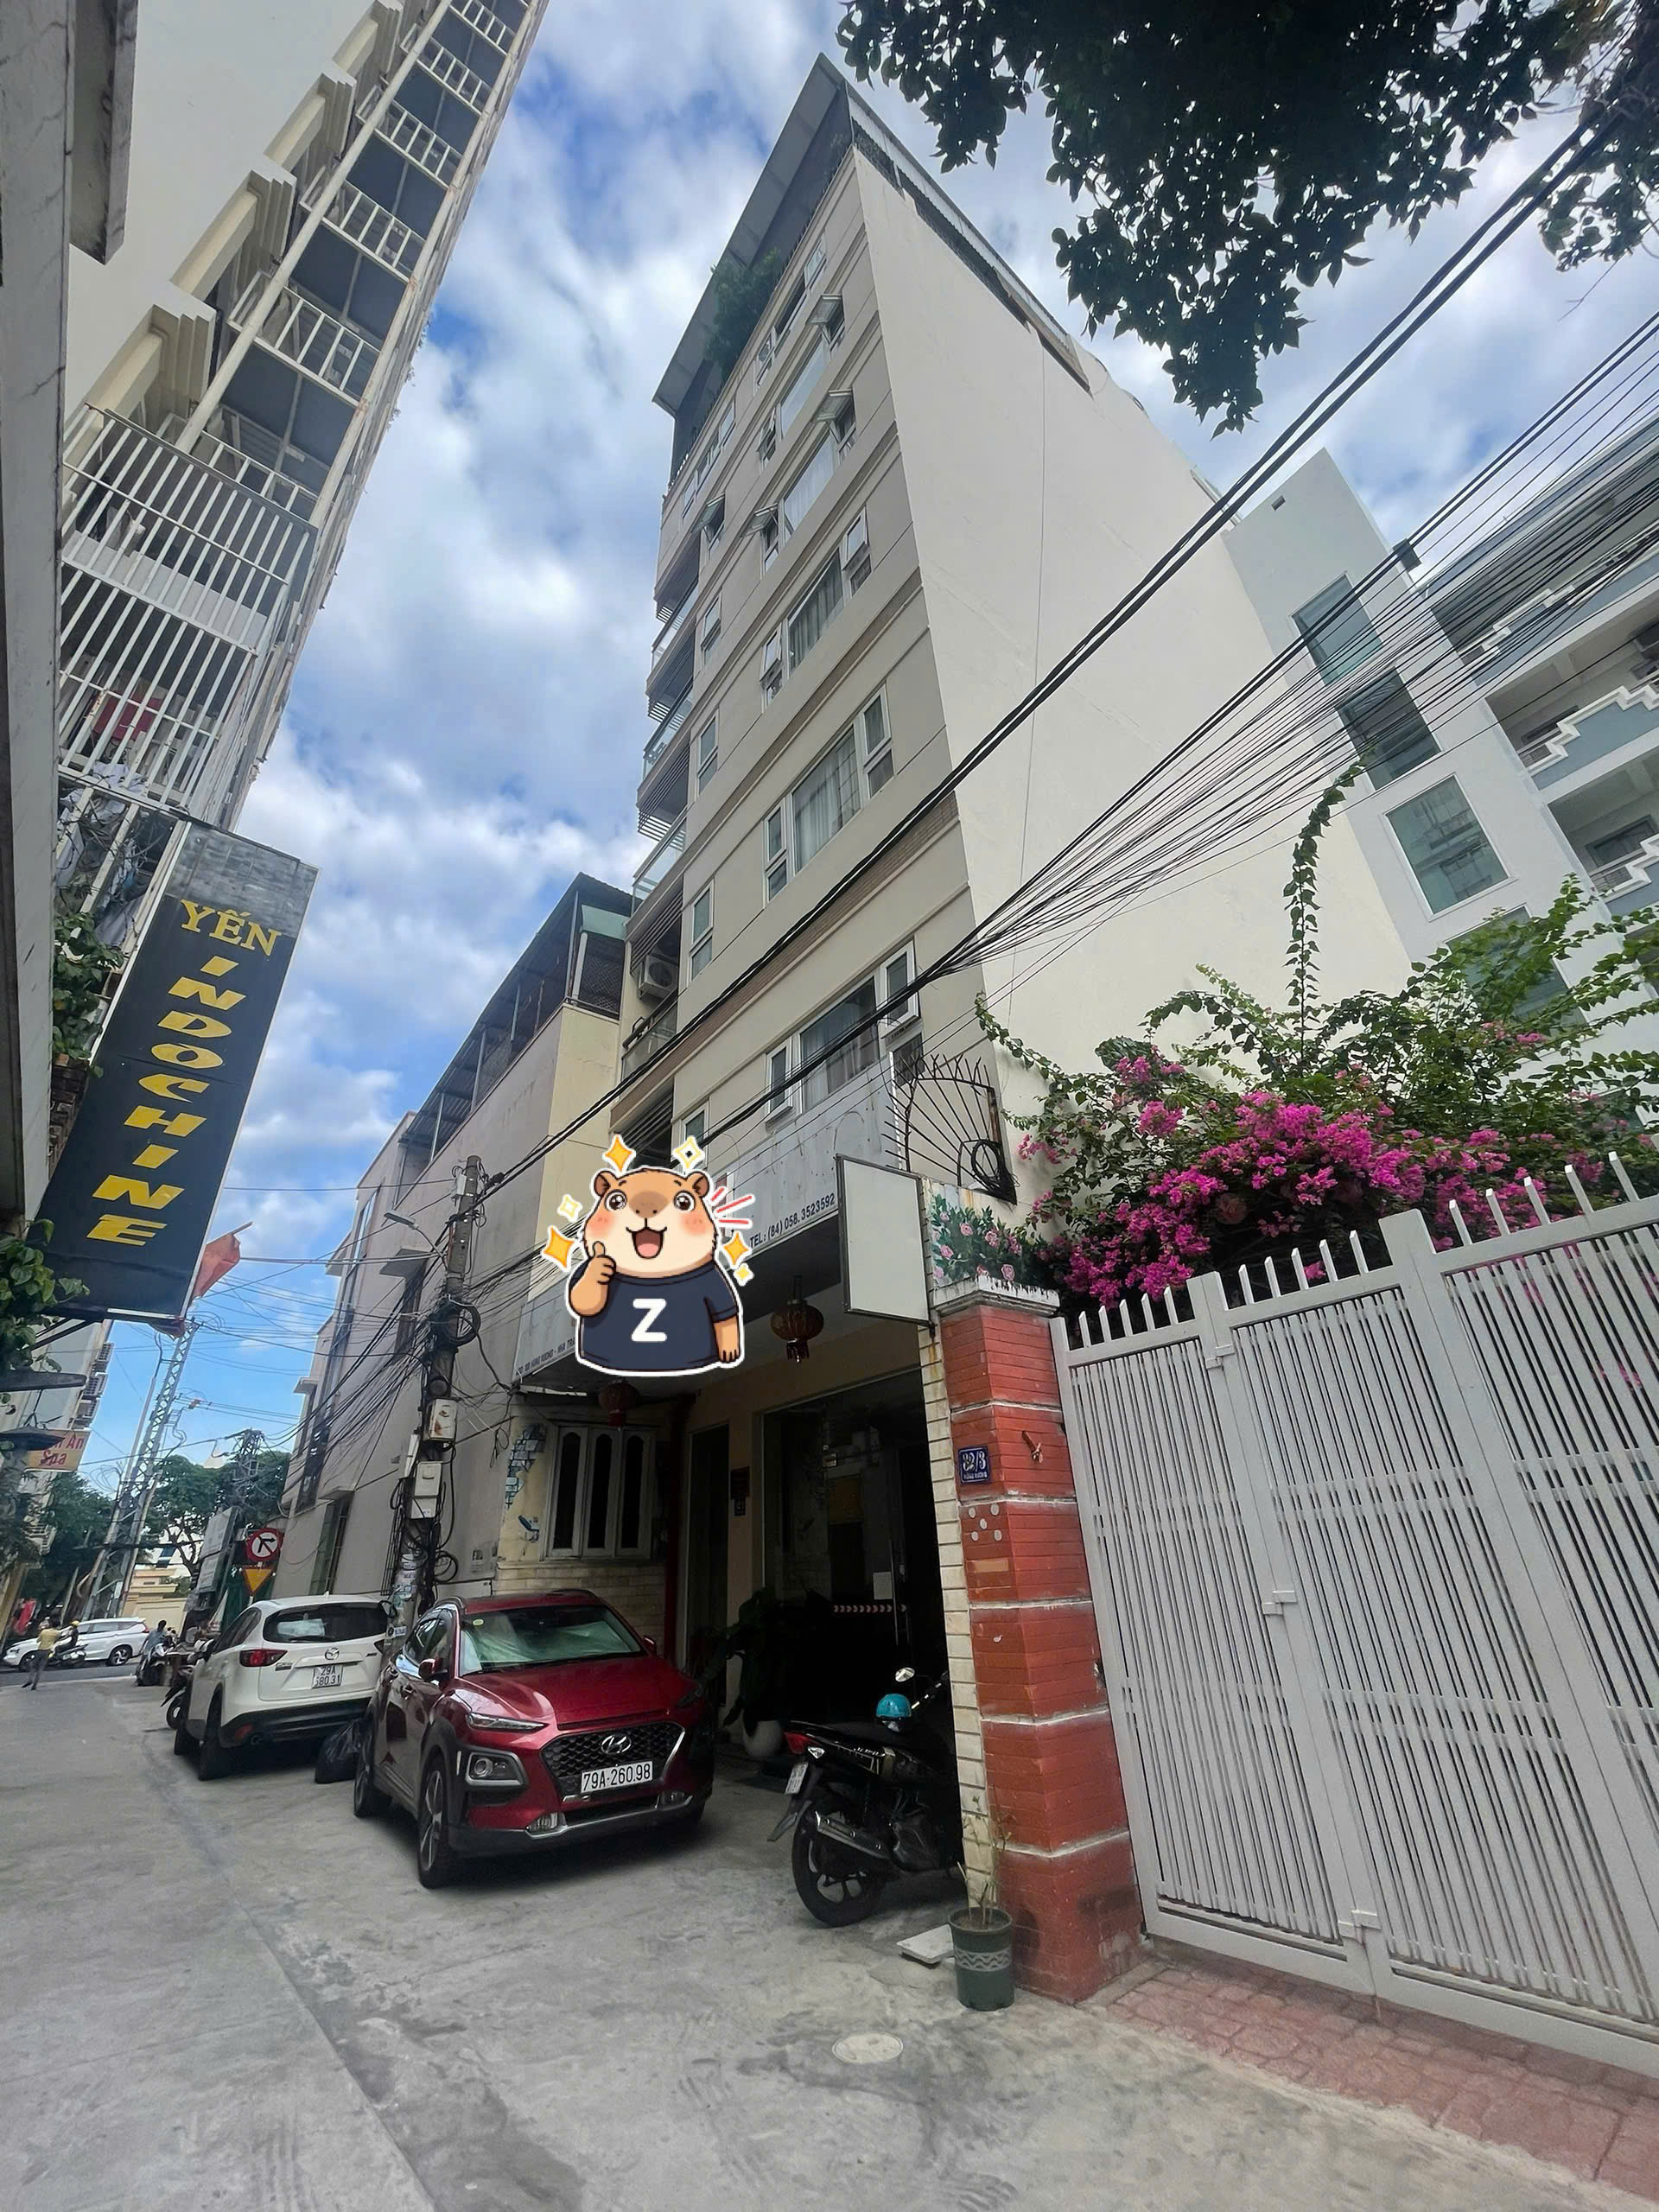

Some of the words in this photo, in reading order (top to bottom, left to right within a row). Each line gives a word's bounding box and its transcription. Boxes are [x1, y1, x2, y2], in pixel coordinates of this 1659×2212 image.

[181, 899, 282, 957] YẾN
[86, 955, 247, 1246] INDOCHINE
[749, 1232, 766, 1249] TEL:
[767, 1220, 783, 1240] (84)
[801, 1192, 836, 1220] 3523592
[39, 1450, 67, 1466] Spa
[321, 1666, 336, 1676] 29A
